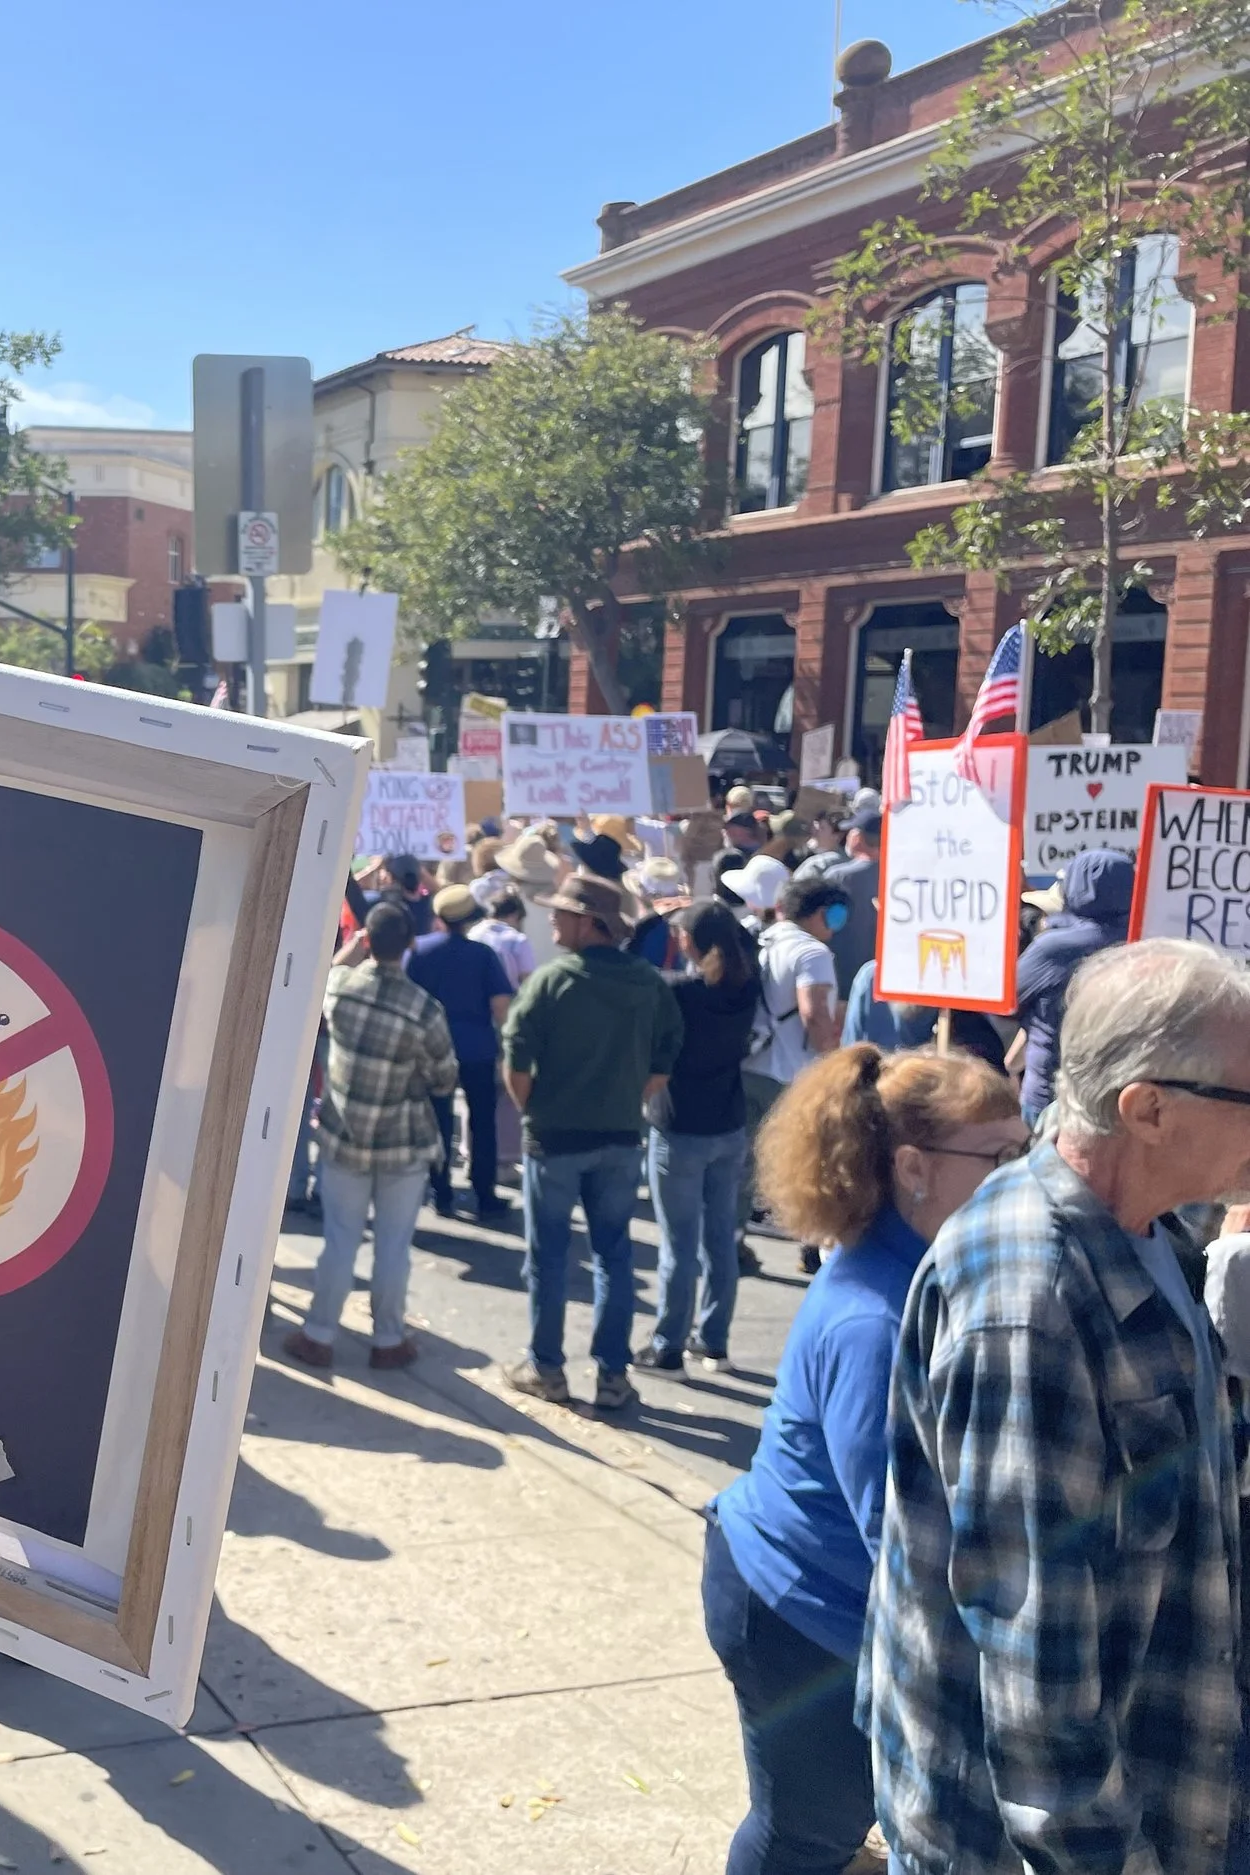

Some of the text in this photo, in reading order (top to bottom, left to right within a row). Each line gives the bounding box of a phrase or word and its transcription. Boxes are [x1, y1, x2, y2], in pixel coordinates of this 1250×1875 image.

[599, 722, 642, 752] ASS
[1047, 751, 1141, 778] TRUMP
[378, 775, 419, 801] KING
[1035, 809, 1139, 833] EPSTEIN
[934, 829, 973, 858] the
[889, 877, 999, 924] STUPID
